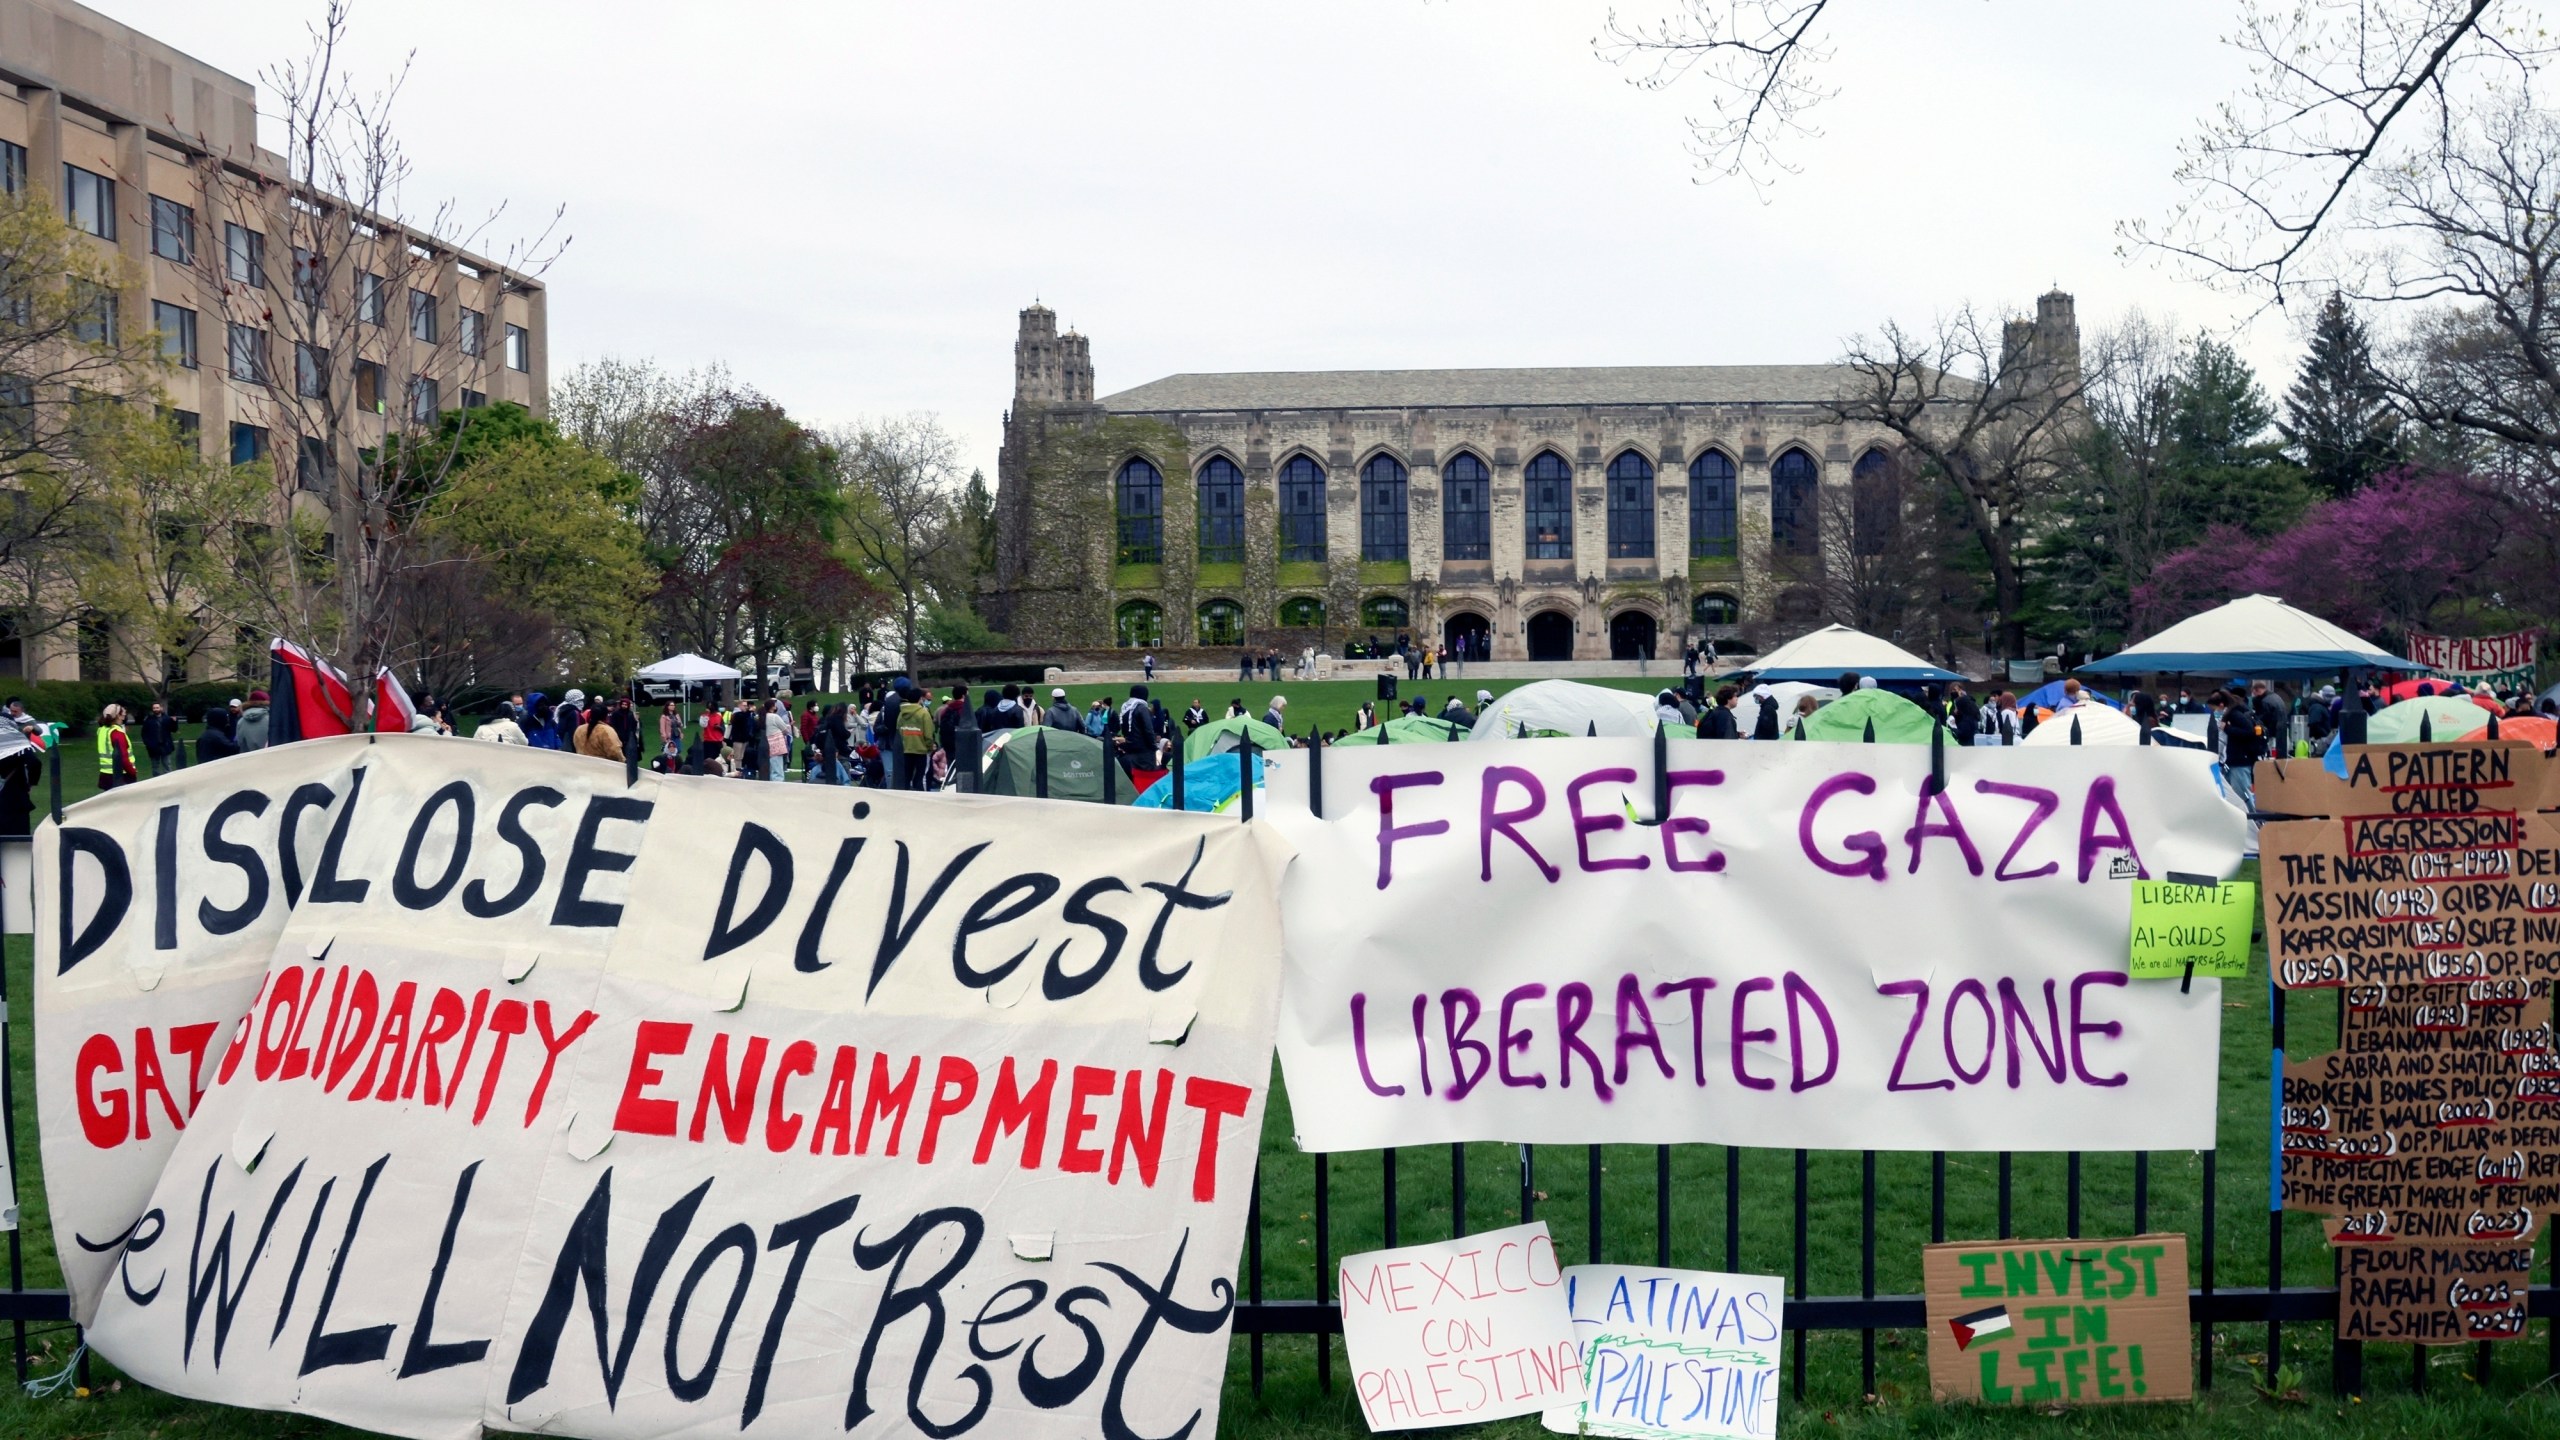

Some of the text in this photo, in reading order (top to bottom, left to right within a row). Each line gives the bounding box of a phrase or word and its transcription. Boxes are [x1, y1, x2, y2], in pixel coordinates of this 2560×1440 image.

[2407, 629, 2536, 670] FREE PALESTINE
[2351, 749, 2509, 788] A PATTERN
[2393, 789, 2479, 813] CALLED
[1370, 765, 2149, 891] FREE GAZA
[57, 765, 655, 976] DISCLOSE
[2280, 854, 2326, 887] THE
[2334, 854, 2408, 884] NAKBA
[2142, 885, 2235, 905] LIBERATE
[2275, 888, 2370, 924] YASSIN
[2442, 883, 2524, 914] QIBYA
[2280, 926, 2337, 955] KAFR
[2338, 923, 2407, 952] QASIM
[2467, 917, 2516, 946] SUEZ
[2523, 917, 2560, 944] INV
[2132, 957, 2146, 970] We
[2163, 958, 2172, 969] all
[2348, 952, 2424, 983] RAFAH
[2486, 951, 2521, 976] OP.
[2422, 983, 2468, 1004] GIFT
[2348, 1006, 2411, 1030] LITANI
[2468, 1004, 2526, 1027] FIRST
[1350, 970, 2128, 1104] LIBERATED ZONE
[2347, 1030, 2441, 1054] LEBANON
[2451, 1029, 2498, 1050] WAR
[2325, 1053, 2392, 1079] SABRA
[2397, 1054, 2434, 1076] AND
[2439, 1052, 2517, 1077] SHATILA
[2283, 1077, 2372, 1108] BROKEN
[2380, 1078, 2448, 1105] BONES
[2451, 1075, 2516, 1100] POLICY
[75, 1021, 220, 1149] GAZ
[613, 1020, 1252, 1203] ENCAMPMENT
[2332, 1108, 2374, 1133] THE
[2380, 1105, 2439, 1130] WALL
[2495, 1101, 2525, 1122] OP.
[2399, 1132, 2427, 1153] OP.
[2431, 1127, 2489, 1153] PILLAR
[2312, 1157, 2422, 1182] PROTECTIVE
[2426, 1156, 2474, 1181] EDGE
[2528, 1151, 2560, 1178] REP
[2302, 1182, 2336, 1205] THE
[2338, 1184, 2403, 1211] GREAT
[2407, 1185, 2465, 1209] MARCH
[2497, 1183, 2560, 1209] RETURN
[2389, 1212, 2459, 1237] JENIN
[1340, 1236, 1562, 1319] MEXICO
[1959, 1245, 2164, 1300] INVEST
[2351, 1247, 2531, 1275] FLOUR MASSACRE
[183, 1153, 491, 1380] WILL
[505, 1166, 861, 1430] NOT
[2351, 1277, 2435, 1307] RAFAH
[1569, 1275, 1777, 1345] LATINAS
[2347, 1310, 2461, 1338] AL-SHIFA
[1422, 1317, 1491, 1356] CON
[2024, 1305, 2108, 1349] IN
[1358, 1341, 1588, 1427] PALESTINA
[1979, 1344, 2147, 1402] LIFE!
[1595, 1349, 1779, 1434] PALESTINE
